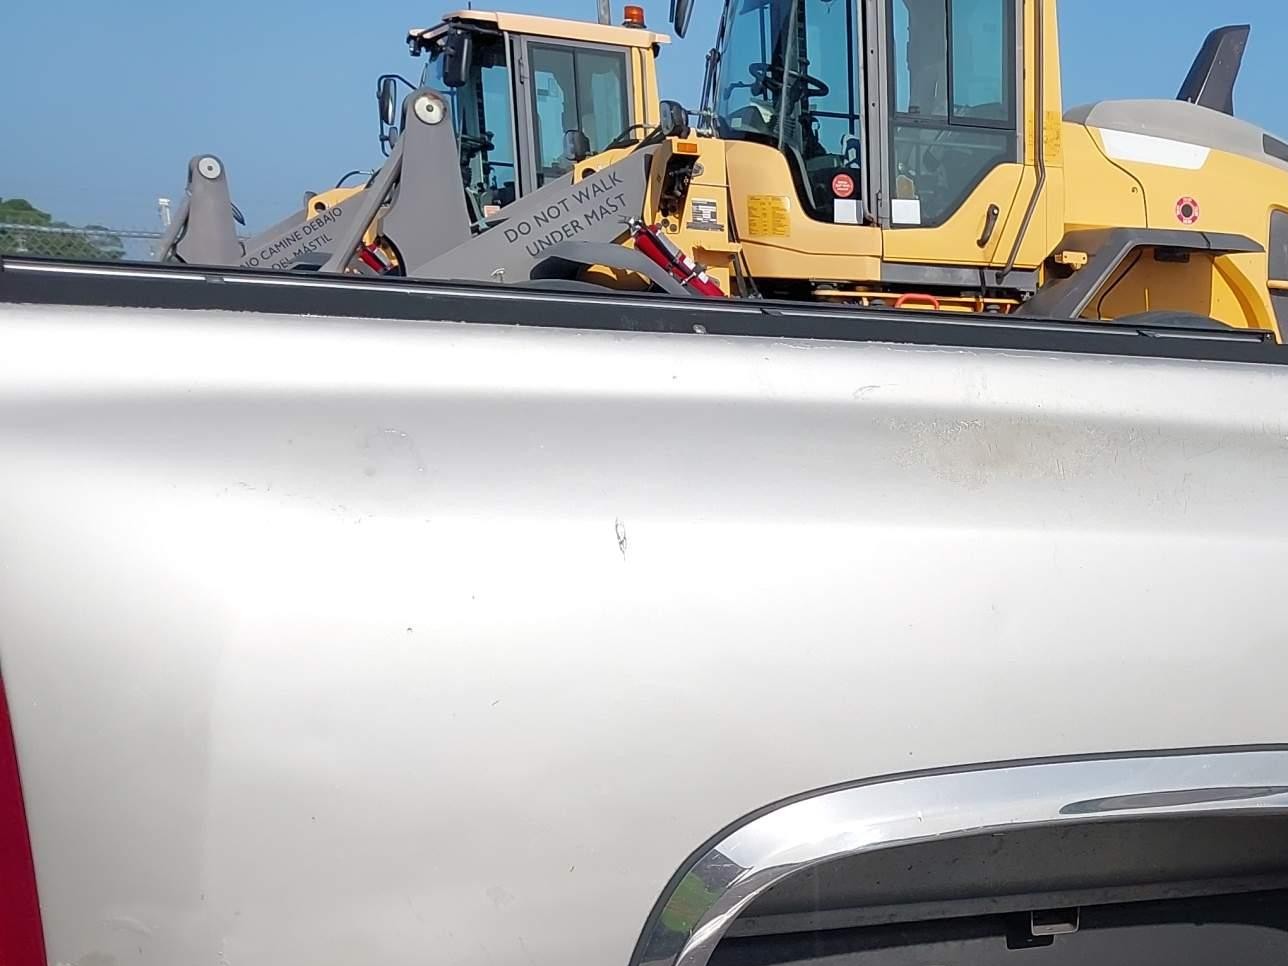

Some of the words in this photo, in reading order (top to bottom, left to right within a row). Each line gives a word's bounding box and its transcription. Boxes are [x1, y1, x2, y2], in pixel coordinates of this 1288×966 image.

[260, 230, 303, 260] CAMINE
[302, 207, 342, 236] DEBAJO
[503, 221, 532, 243] DO
[533, 198, 570, 228] NOT
[571, 171, 623, 204] WALK
[525, 219, 585, 257] UNDER
[583, 193, 626, 226] MAST
